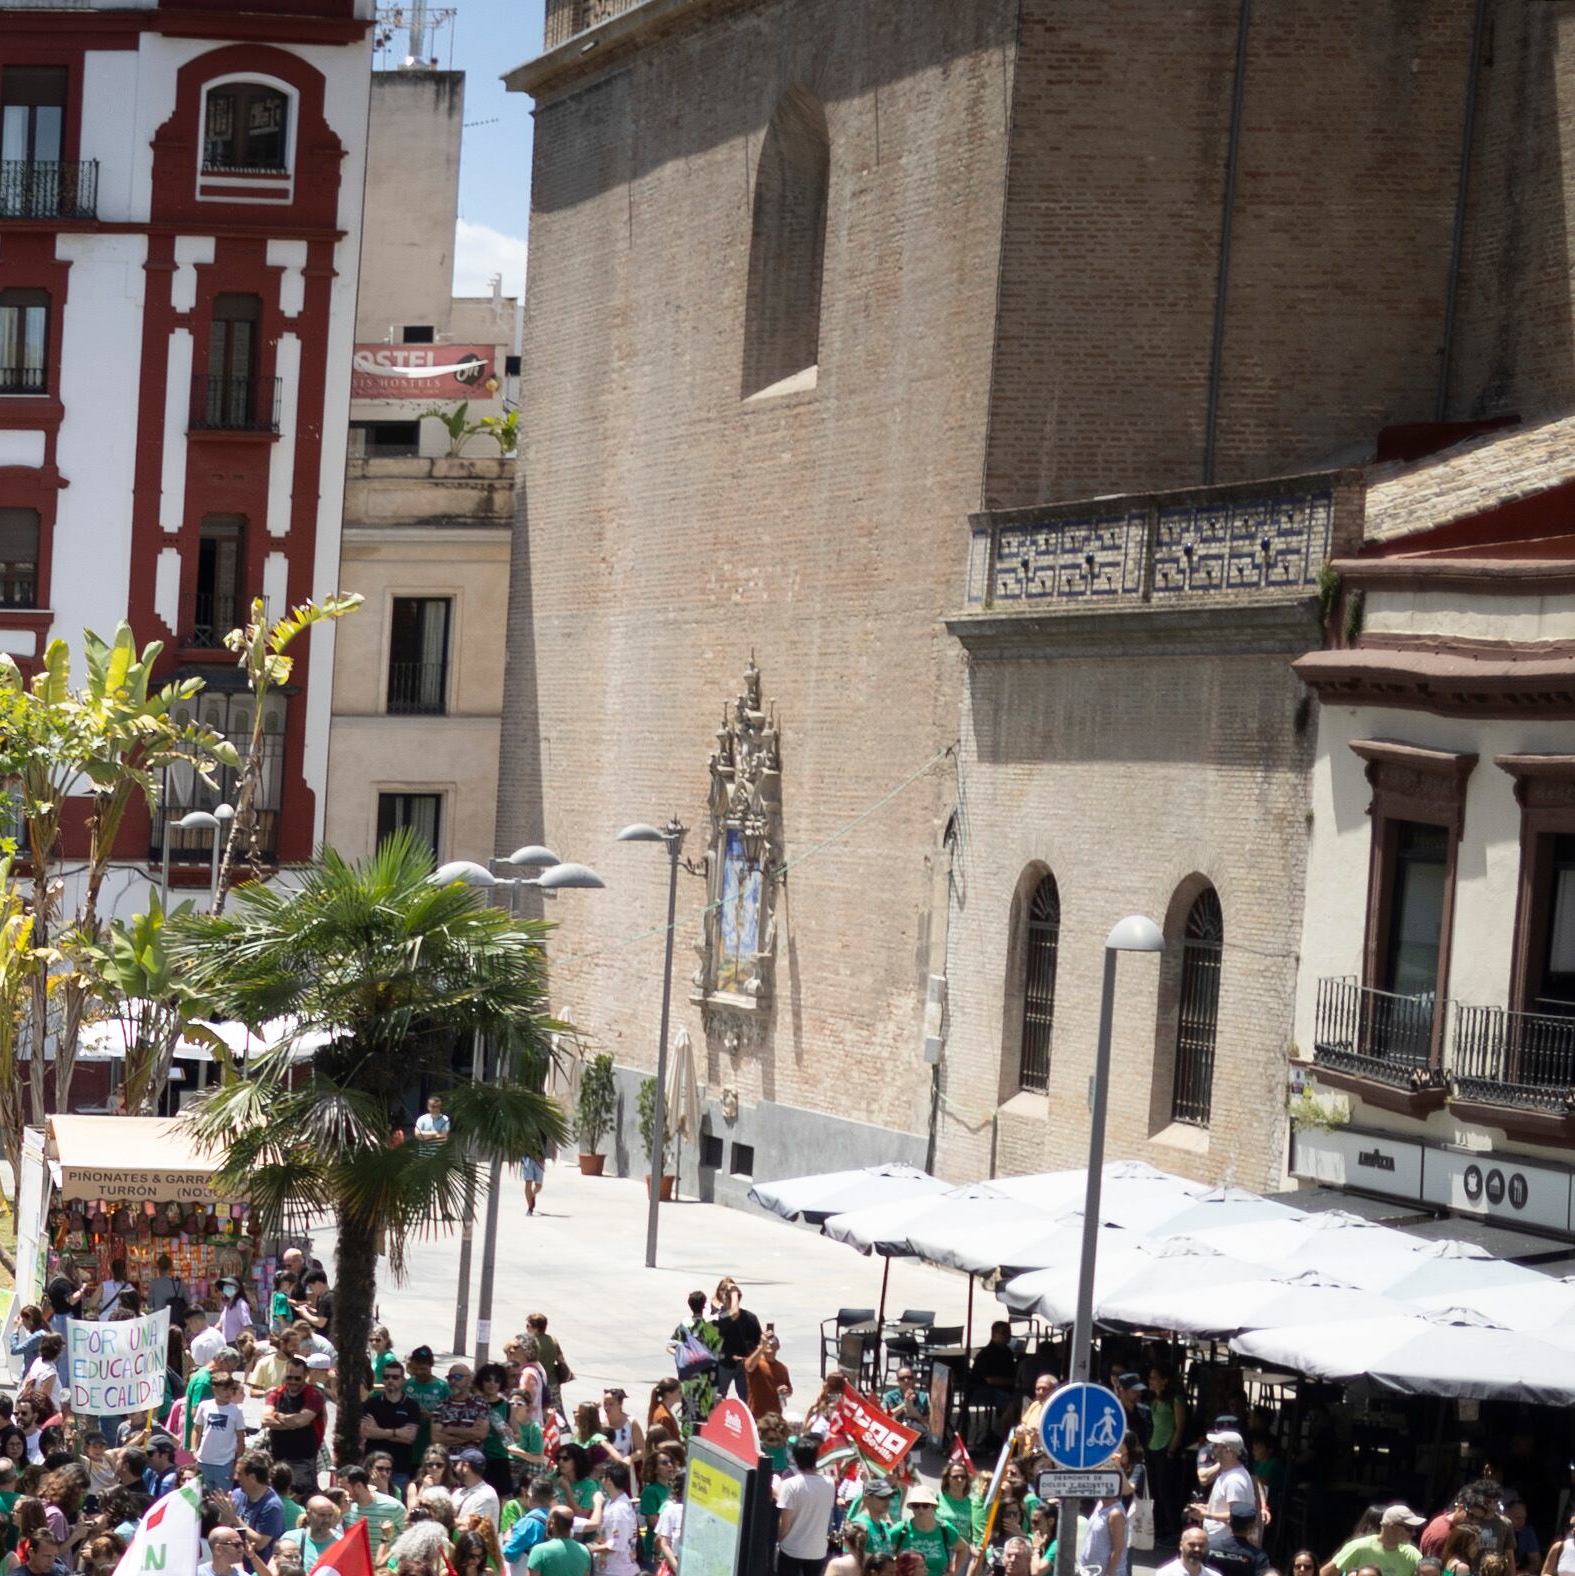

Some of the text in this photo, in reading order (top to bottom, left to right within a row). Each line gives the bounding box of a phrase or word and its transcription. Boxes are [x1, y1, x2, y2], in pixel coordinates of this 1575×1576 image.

[353, 350, 434, 374] OSTEL
[69, 1171, 212, 1185] PIÑONATES & GARRA
[99, 1184, 157, 1196] TURRÓN
[73, 1320, 158, 1354] POR UNA
[75, 1374, 165, 1409] DE CALIDAD
